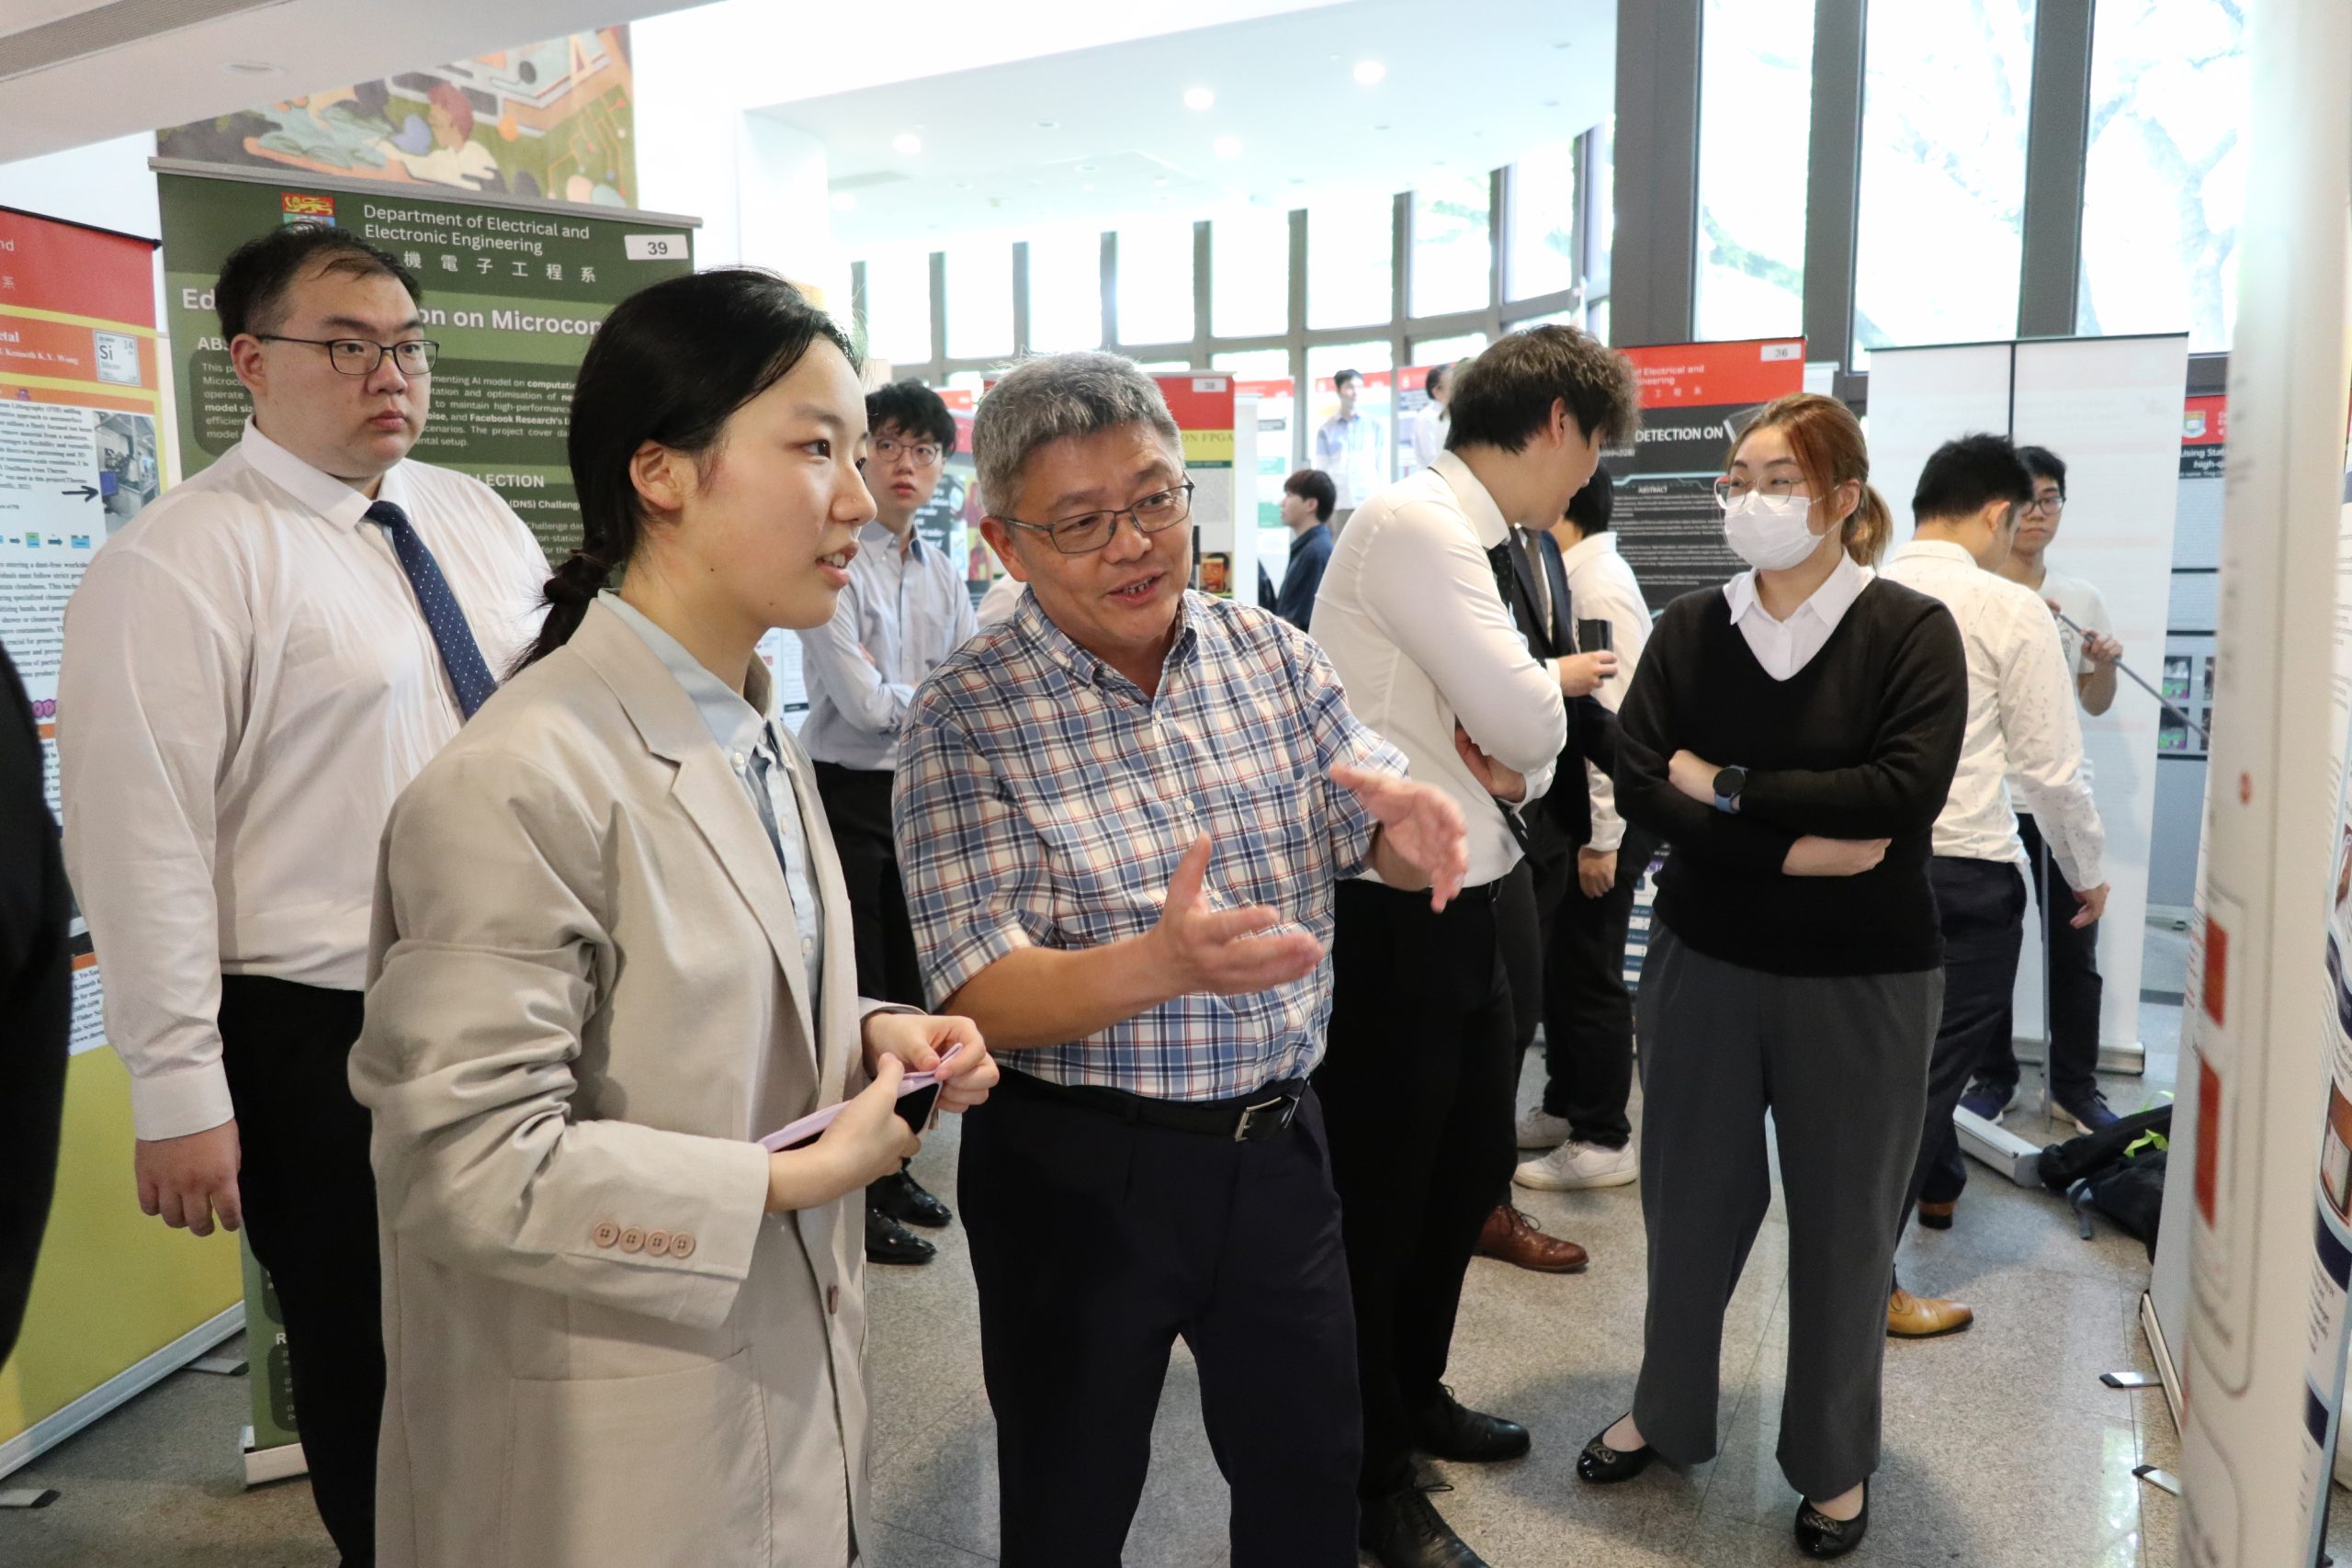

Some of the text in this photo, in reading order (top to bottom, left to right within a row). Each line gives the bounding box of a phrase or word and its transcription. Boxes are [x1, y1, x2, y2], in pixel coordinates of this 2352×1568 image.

[364, 204, 590, 239] Department of Electrical and
[365, 224, 543, 256] Electronic Engineering
[647, 242, 668, 255] 39
[182, 288, 216, 310] Ed
[419, 309, 602, 335] on on Microcon
[99, 344, 113, 361] Si
[1774, 348, 1789, 358] 36
[1644, 365, 1705, 376] Electrical and
[203, 377, 243, 385] Microco
[432, 375, 469, 386] menting
[483, 378, 511, 386] model
[527, 380, 576, 390] computatio
[204, 390, 244, 401] operate
[432, 387, 459, 396] tation
[464, 389, 481, 397] and
[547, 392, 556, 400] of
[205, 404, 237, 413] model
[450, 400, 489, 410] maintain
[494, 402, 571, 413] high-performanc
[451, 413, 468, 421] and
[470, 413, 513, 423] Facebook
[515, 415, 563, 425] Research's
[207, 430, 239, 439] model
[471, 426, 487, 434] The
[492, 427, 524, 437] project
[1202, 432, 1234, 442] FPGA
[1635, 426, 1724, 442] DETECTION ON
[476, 474, 544, 487] ECTION
[1638, 485, 1668, 494] ABSTRACT
